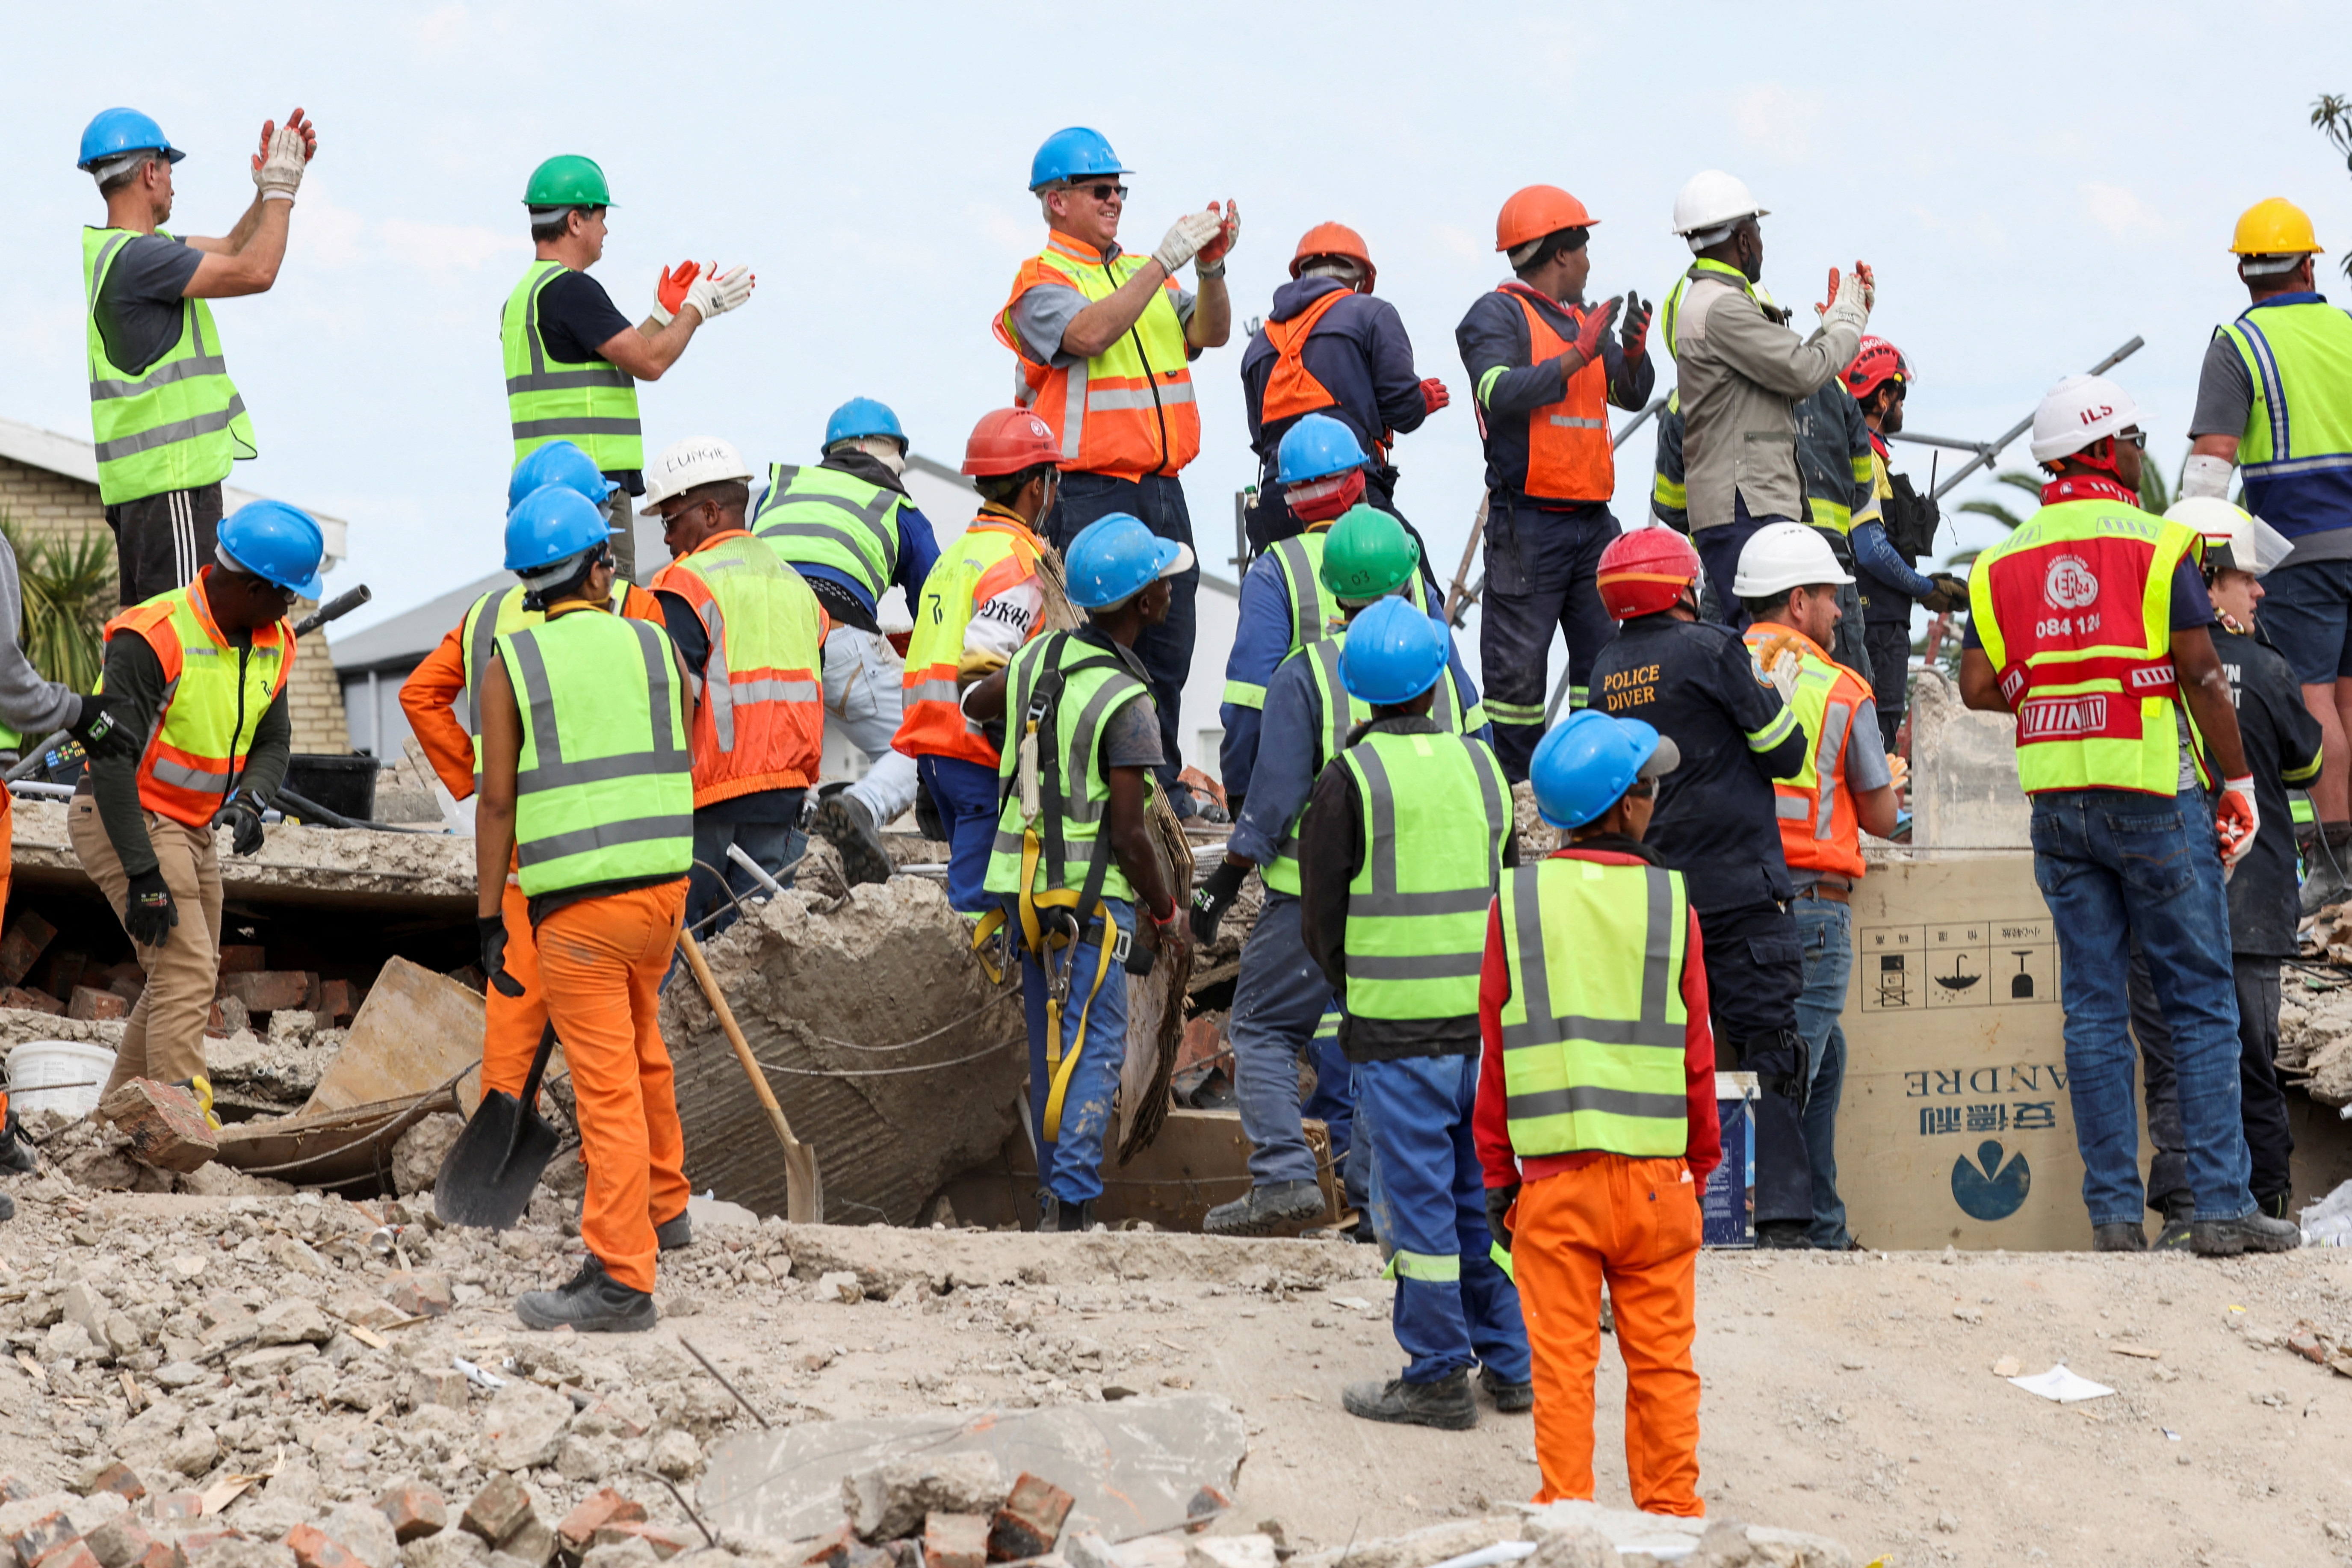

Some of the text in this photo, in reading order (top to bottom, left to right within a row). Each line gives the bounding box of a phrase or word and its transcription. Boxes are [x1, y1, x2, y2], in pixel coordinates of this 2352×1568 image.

[2080, 405, 2113, 426] ILS
[1351, 569, 1370, 586] 03
[2036, 617, 2072, 639] 084
[1603, 664, 1660, 691] POLICE
[1607, 685, 1656, 712] DIVER
[1904, 1064, 2068, 1098] ANDRE
[1919, 1101, 2056, 1137] 安德利
